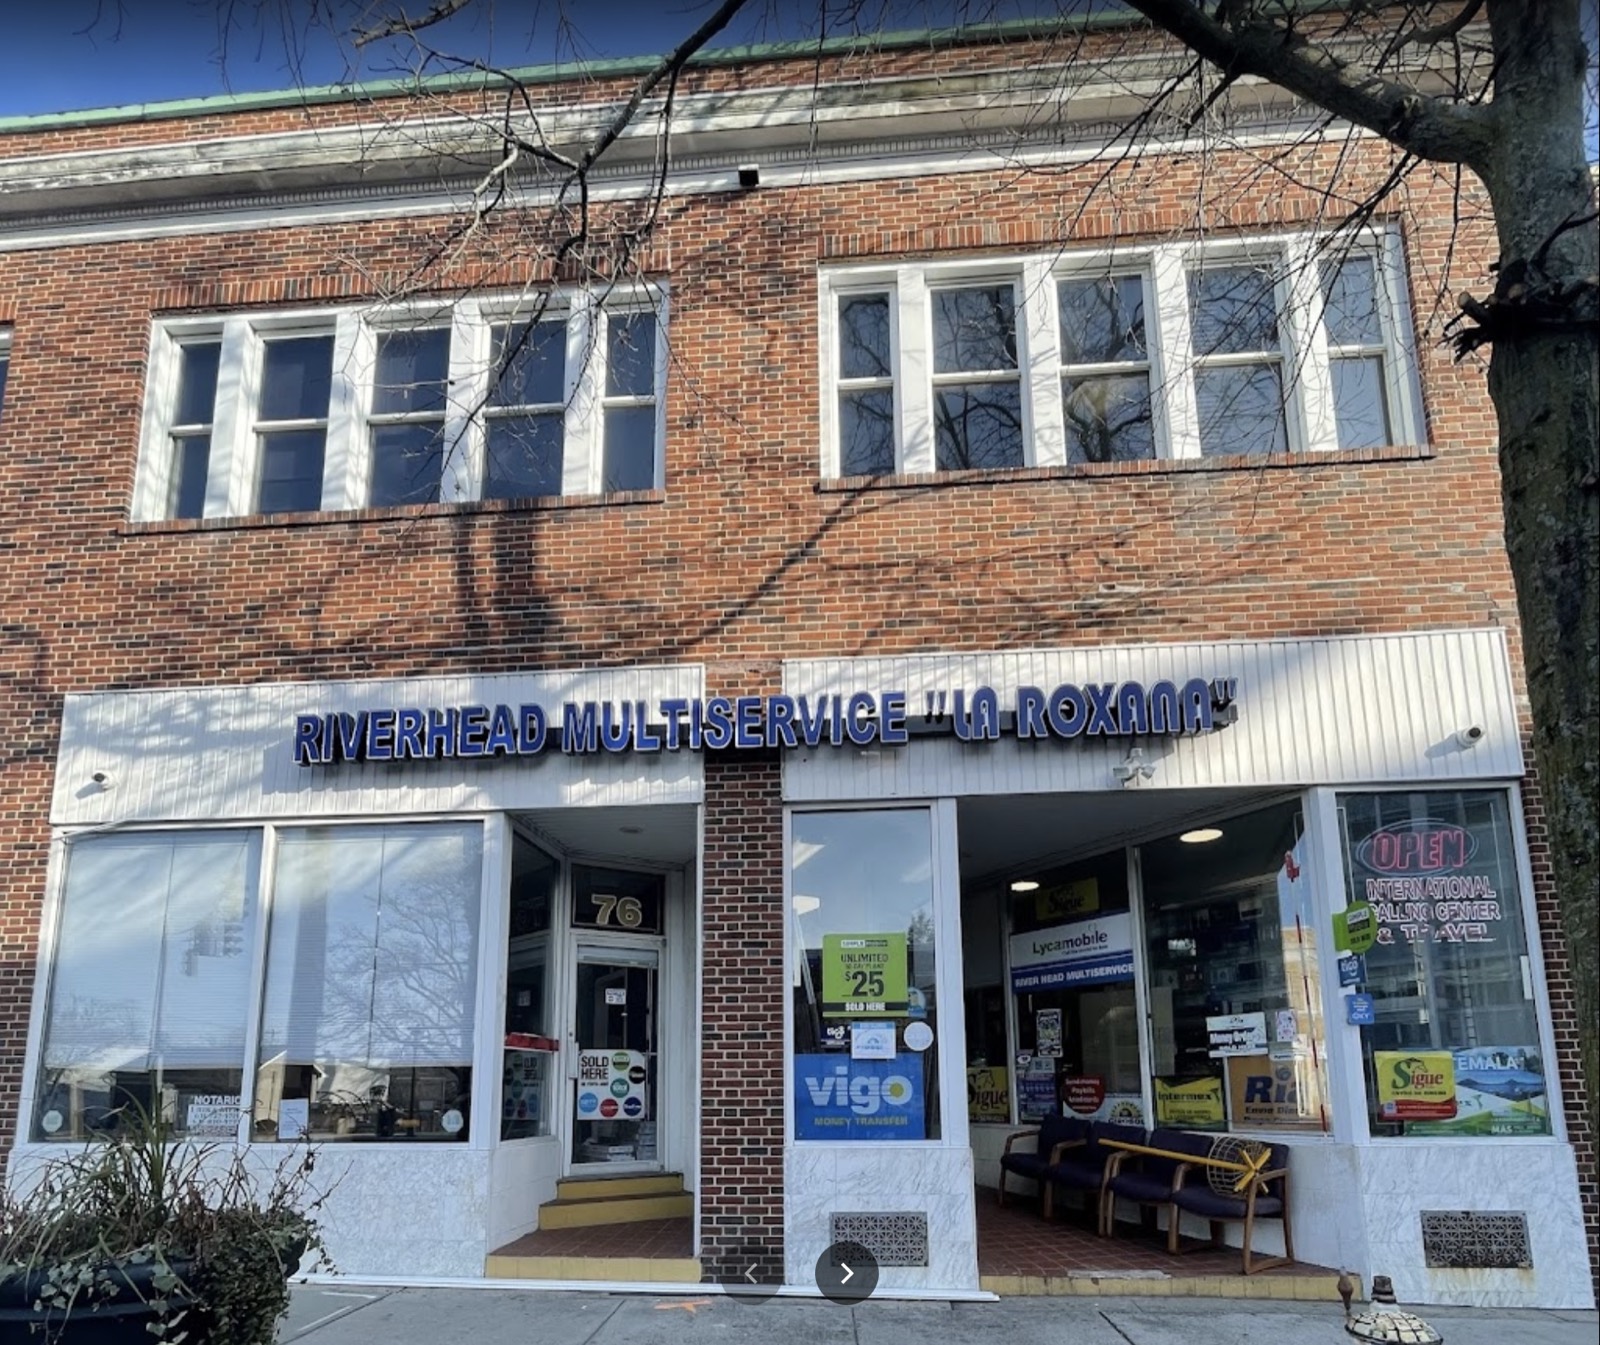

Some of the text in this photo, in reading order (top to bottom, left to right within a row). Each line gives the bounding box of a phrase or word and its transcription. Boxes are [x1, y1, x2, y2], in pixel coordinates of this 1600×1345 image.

[293, 703, 547, 763] RIVERHEAD
[561, 690, 908, 752] MULTISERVICE
[1017, 677, 1238, 738] ROXANA"
[1372, 831, 1464, 869] OPEN
[1366, 877, 1496, 900] INTERNATIONAL
[591, 894, 642, 928] 76
[1435, 901, 1501, 920] CENTER
[1033, 930, 1108, 955] Lycamobile
[1376, 928, 1395, 944] &
[841, 953, 888, 963] UNLIMITED
[845, 970, 884, 997] $25
[1015, 963, 1135, 987] RIVER HEAD MULTISERVICE
[845, 1002, 886, 1011] SOLD HERE
[581, 1056, 609, 1067] SOLD
[1452, 1057, 1518, 1070] EMALA
[581, 1068, 608, 1079] HERE
[1392, 1058, 1444, 1089] Sigue
[805, 1066, 913, 1114] vigo
[814, 1115, 907, 1126] MONEY TRANSFER
